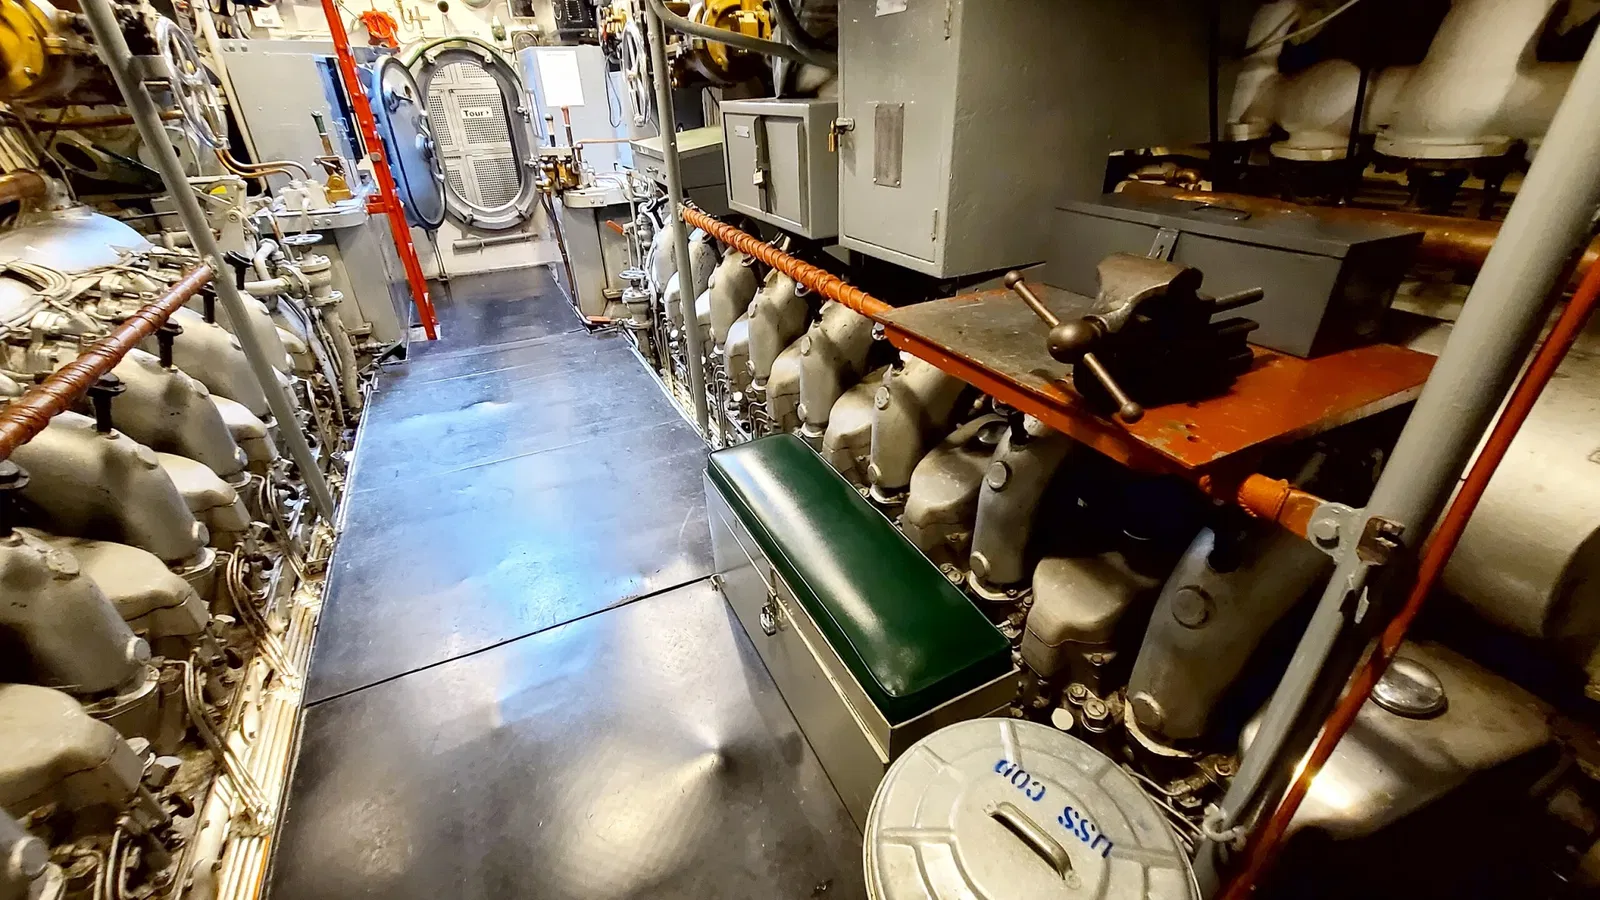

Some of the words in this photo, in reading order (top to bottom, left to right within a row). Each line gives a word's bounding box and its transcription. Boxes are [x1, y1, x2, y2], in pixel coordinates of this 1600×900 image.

[463, 109, 484, 117] Tour
[993, 759, 1046, 802] COD
[1058, 806, 1113, 858] USS
